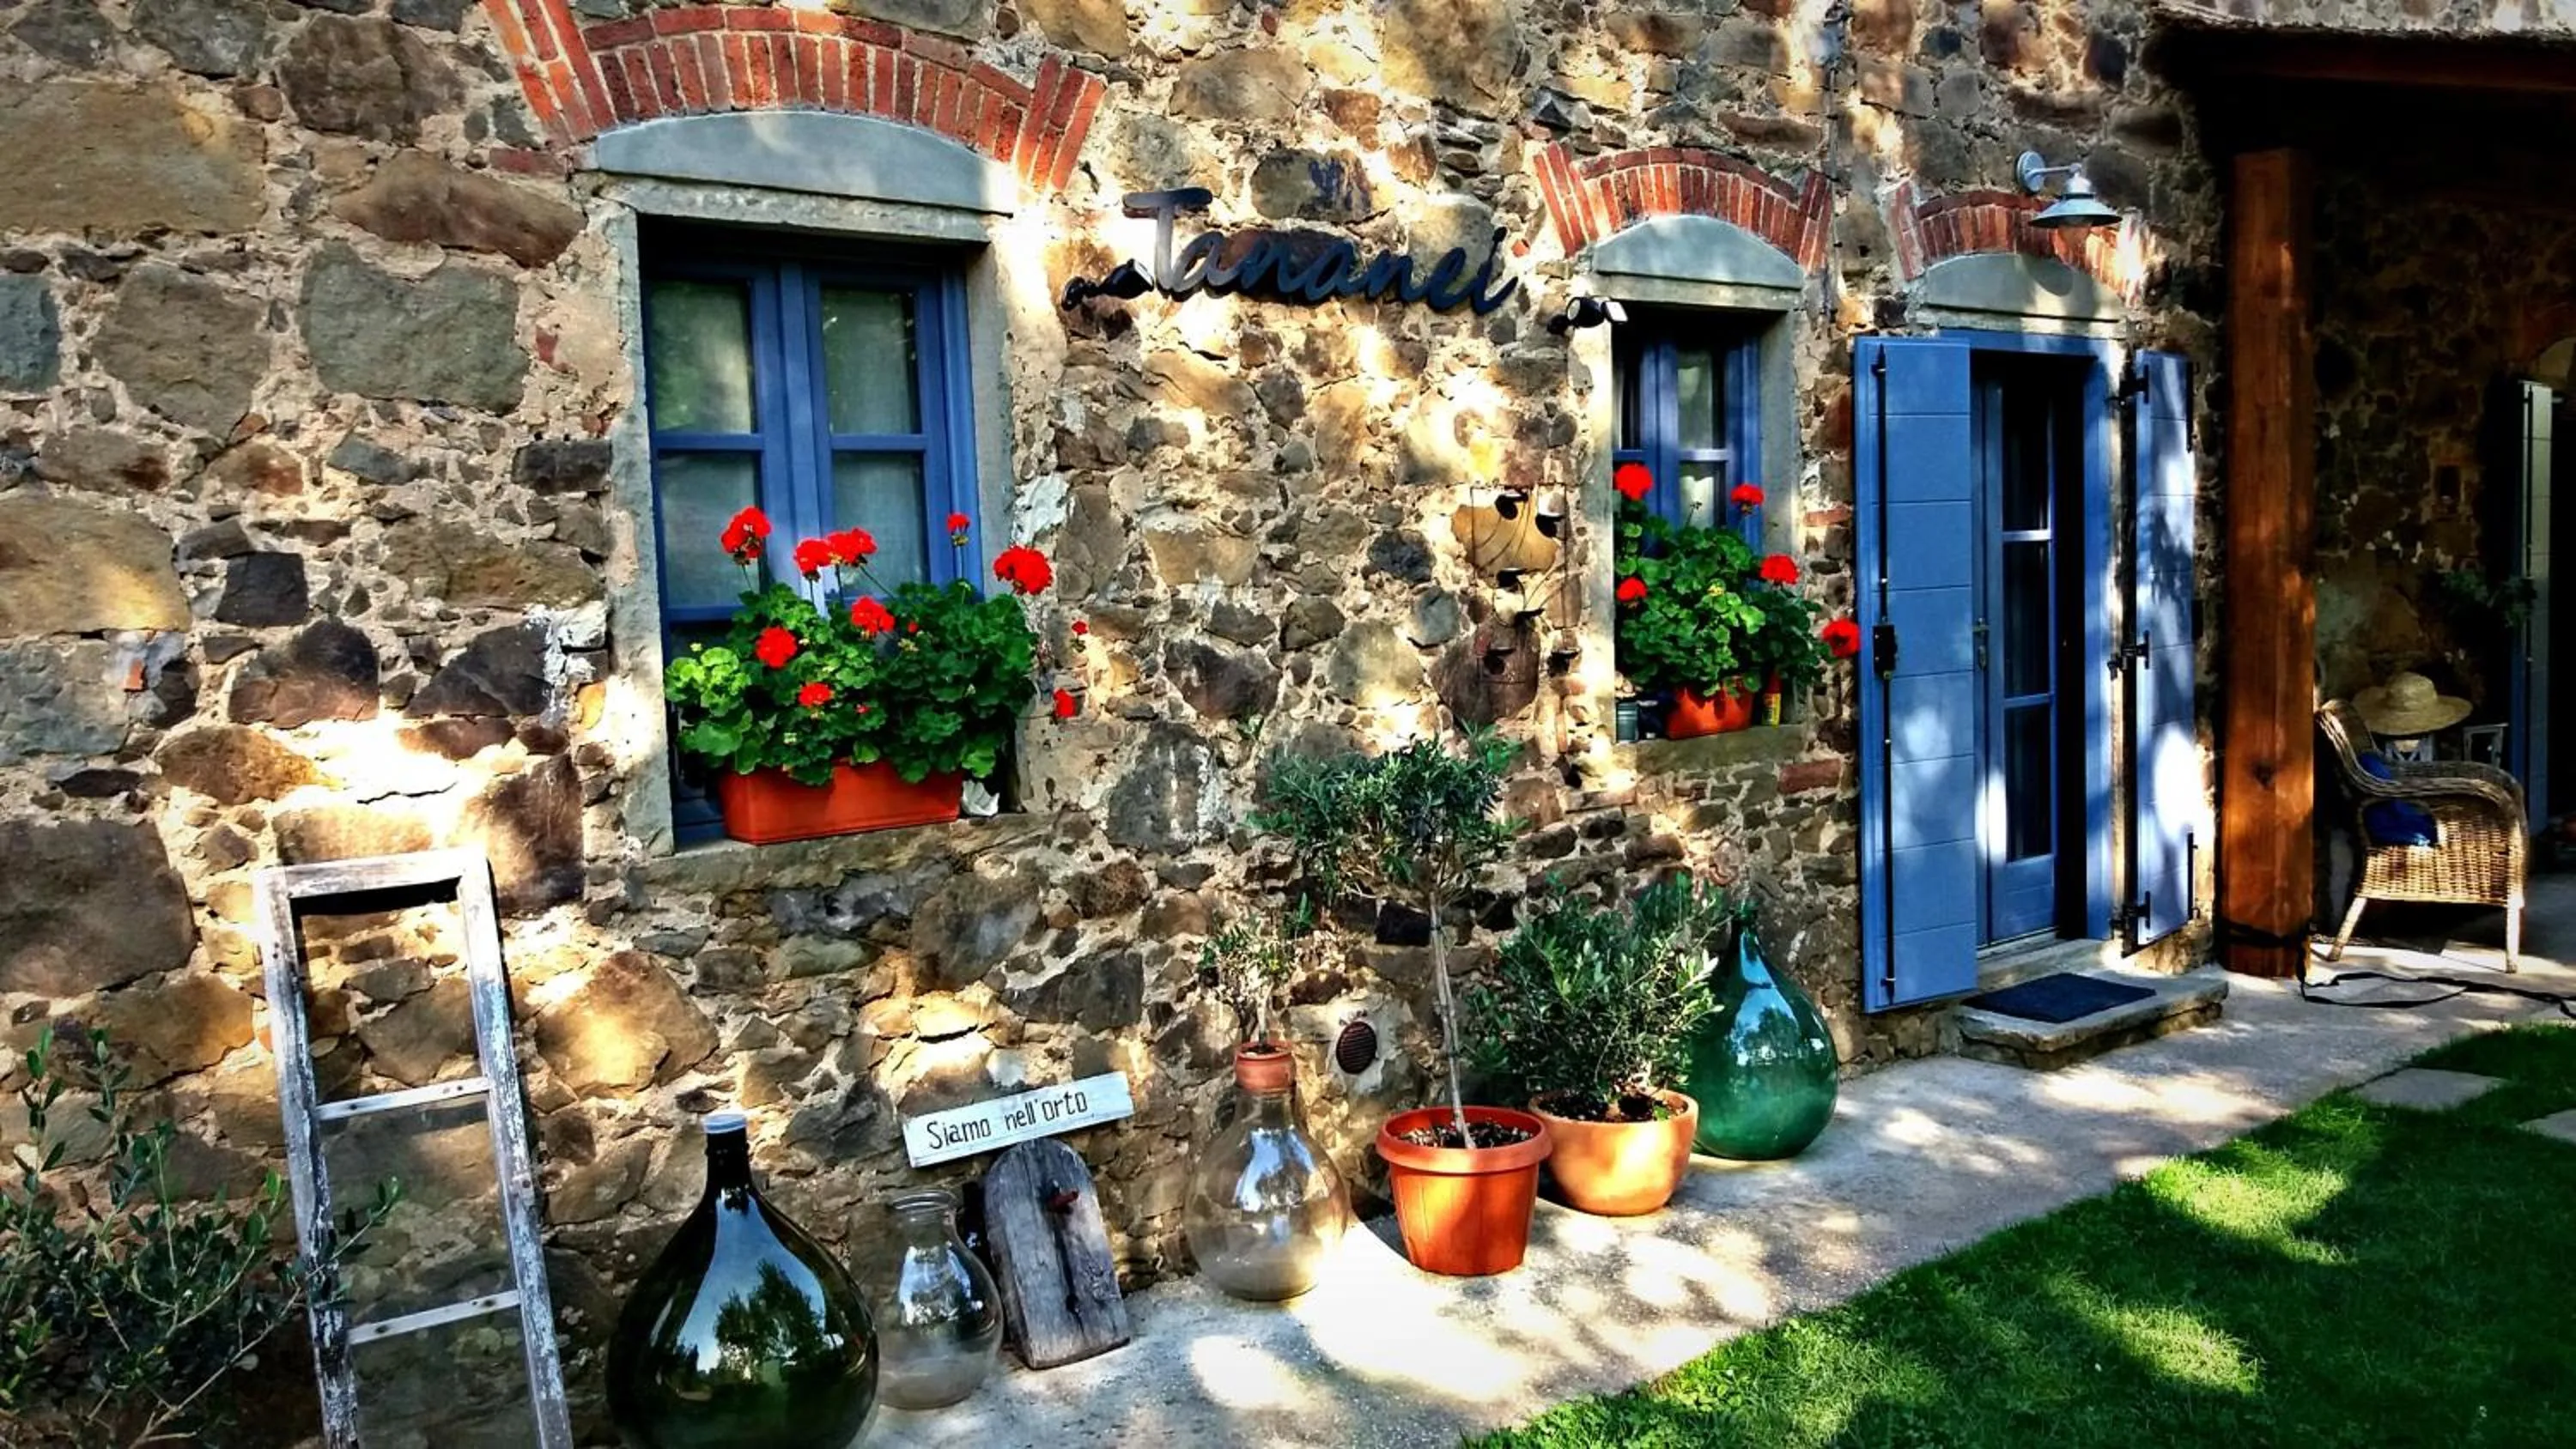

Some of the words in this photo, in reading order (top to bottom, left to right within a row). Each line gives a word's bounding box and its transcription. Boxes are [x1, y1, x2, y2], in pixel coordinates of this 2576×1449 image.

[1121, 187, 1517, 315] Tananei
[927, 1118, 991, 1149] Siamo
[1004, 1090, 1088, 1131] nell'orto
